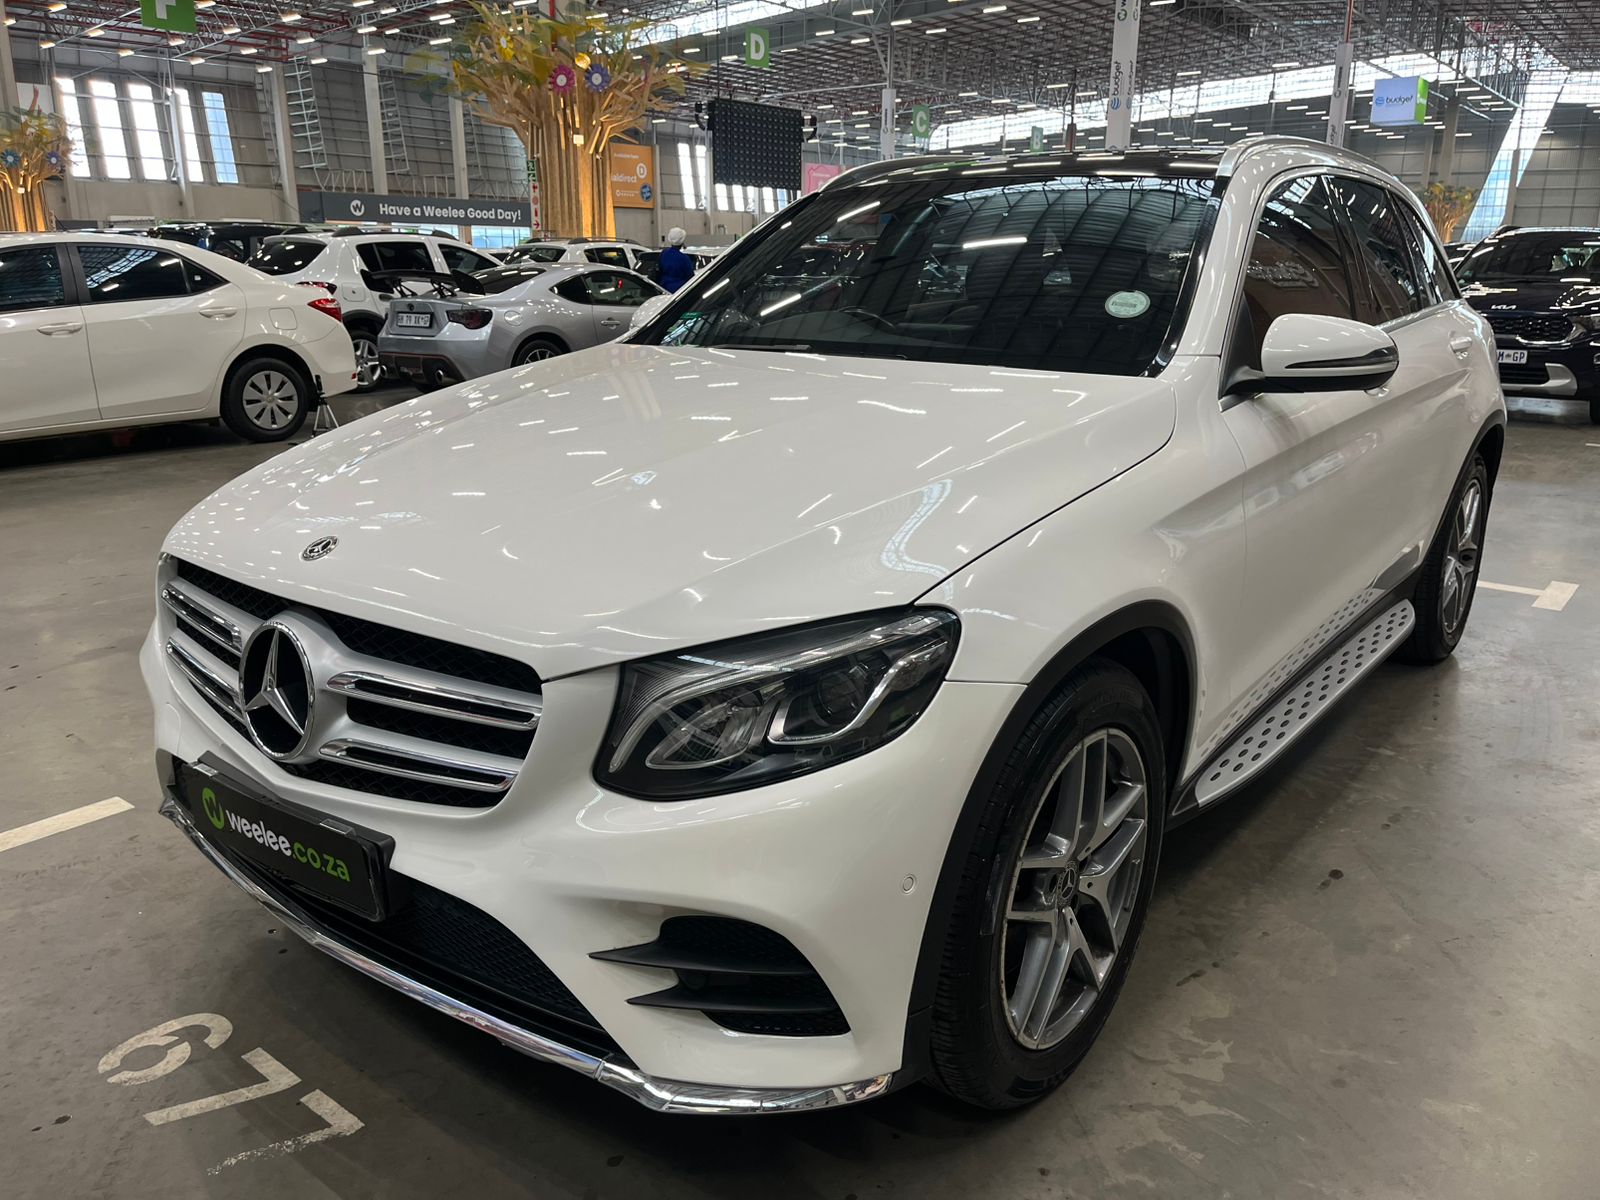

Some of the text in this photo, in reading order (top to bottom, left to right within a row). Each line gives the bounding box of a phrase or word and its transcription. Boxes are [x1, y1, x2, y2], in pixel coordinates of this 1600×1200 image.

[750, 33, 765, 60] D
[1385, 95, 1414, 106] budget
[916, 111, 927, 133] C
[379, 203, 411, 217] Have
[413, 207, 421, 217] a
[423, 204, 465, 218] Weelee
[467, 207, 496, 219] Good
[497, 208, 522, 223] Day!
[1512, 351, 1525, 362] GP
[226, 809, 350, 882] weelee.co.za
